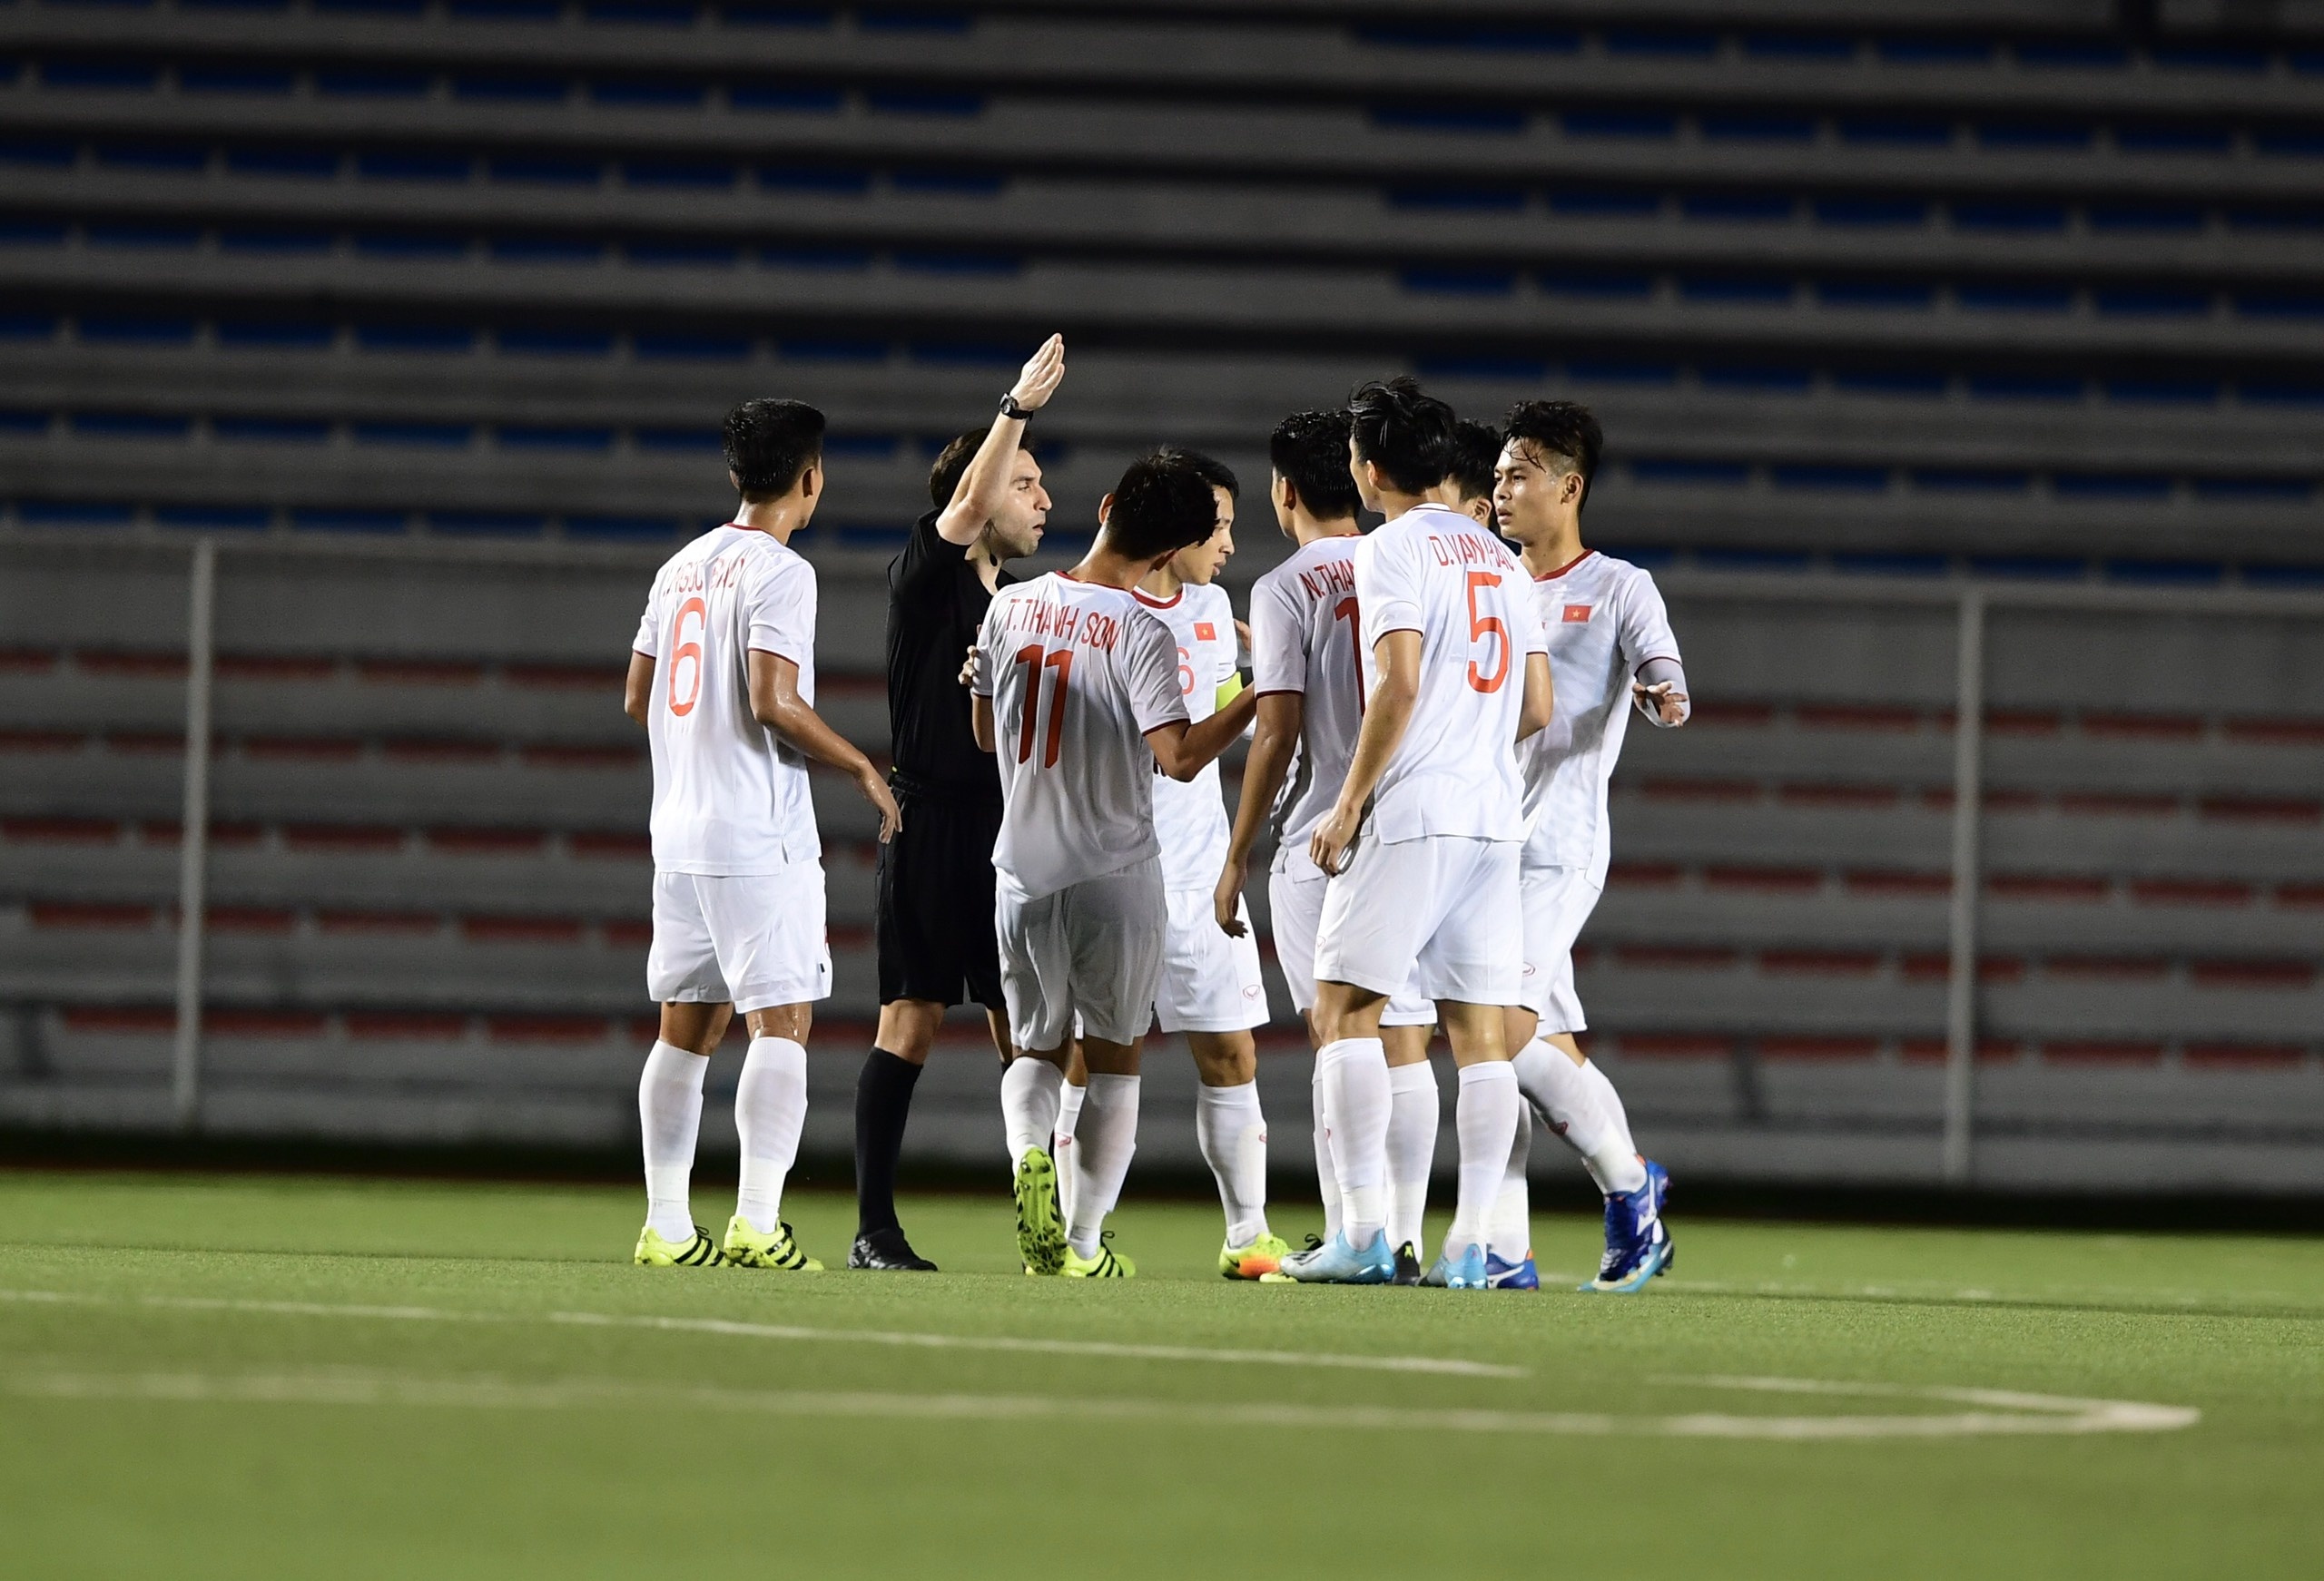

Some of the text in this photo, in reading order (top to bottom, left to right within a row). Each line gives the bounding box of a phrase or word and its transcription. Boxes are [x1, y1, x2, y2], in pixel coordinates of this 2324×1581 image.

[669, 596, 706, 717] 6
[1005, 598, 1122, 653] T.THANH SON
[1467, 571, 1508, 692] 5
[1015, 643, 1074, 770] 11
